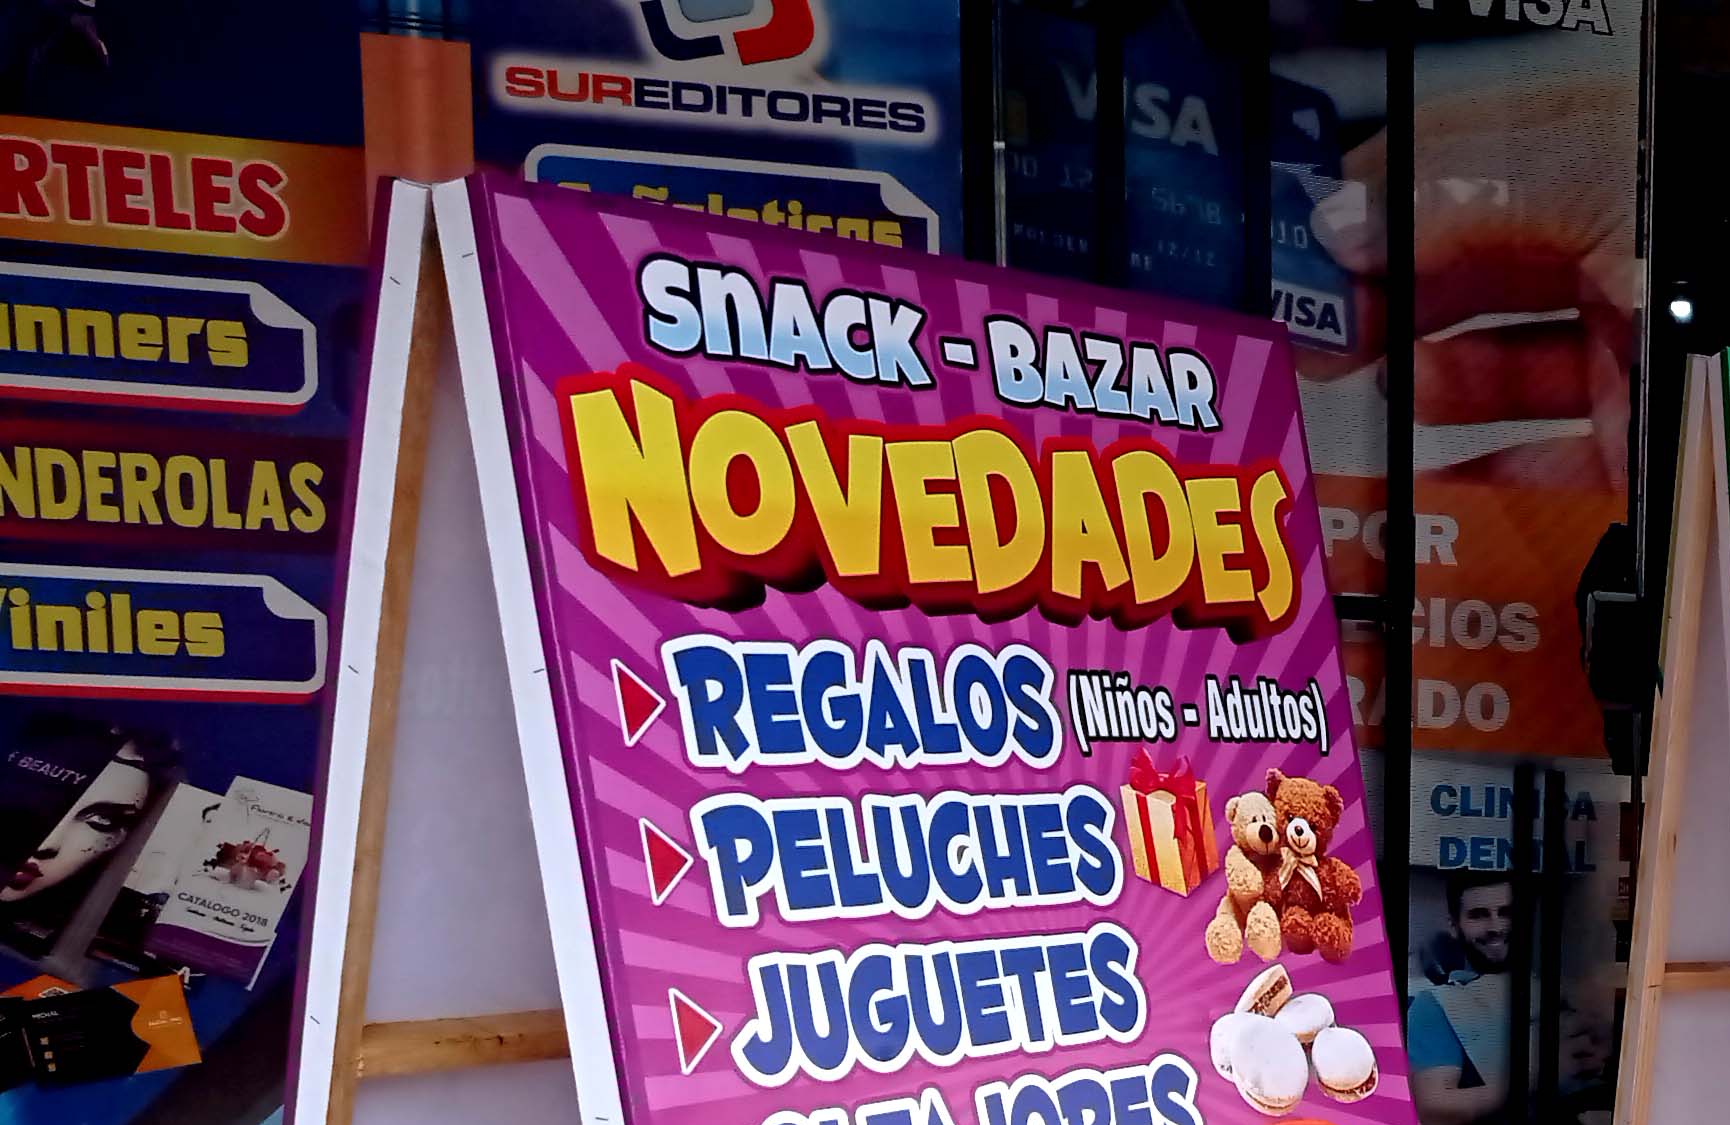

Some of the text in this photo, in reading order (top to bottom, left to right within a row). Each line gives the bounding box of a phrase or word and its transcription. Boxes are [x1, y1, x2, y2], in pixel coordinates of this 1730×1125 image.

[505, 66, 926, 134] SUREDITORES
[1058, 62, 1219, 157] VSA
[985, 318, 1220, 430] BAZAR
[567, 378, 1295, 624] NOVEDADES
[0, 586, 225, 658] iniles
[668, 640, 1058, 766] REGALOS
[1068, 674, 1176, 753] (Niños
[1206, 678, 1328, 752] Adultos)
[19, 758, 87, 786] BEAUTY
[1430, 784, 1597, 823] CLINA
[700, 793, 1118, 920] PELUCHES
[178, 891, 240, 918] CATALOGO
[242, 912, 269, 928] 2018
[739, 930, 1141, 1080] JUGUETES
